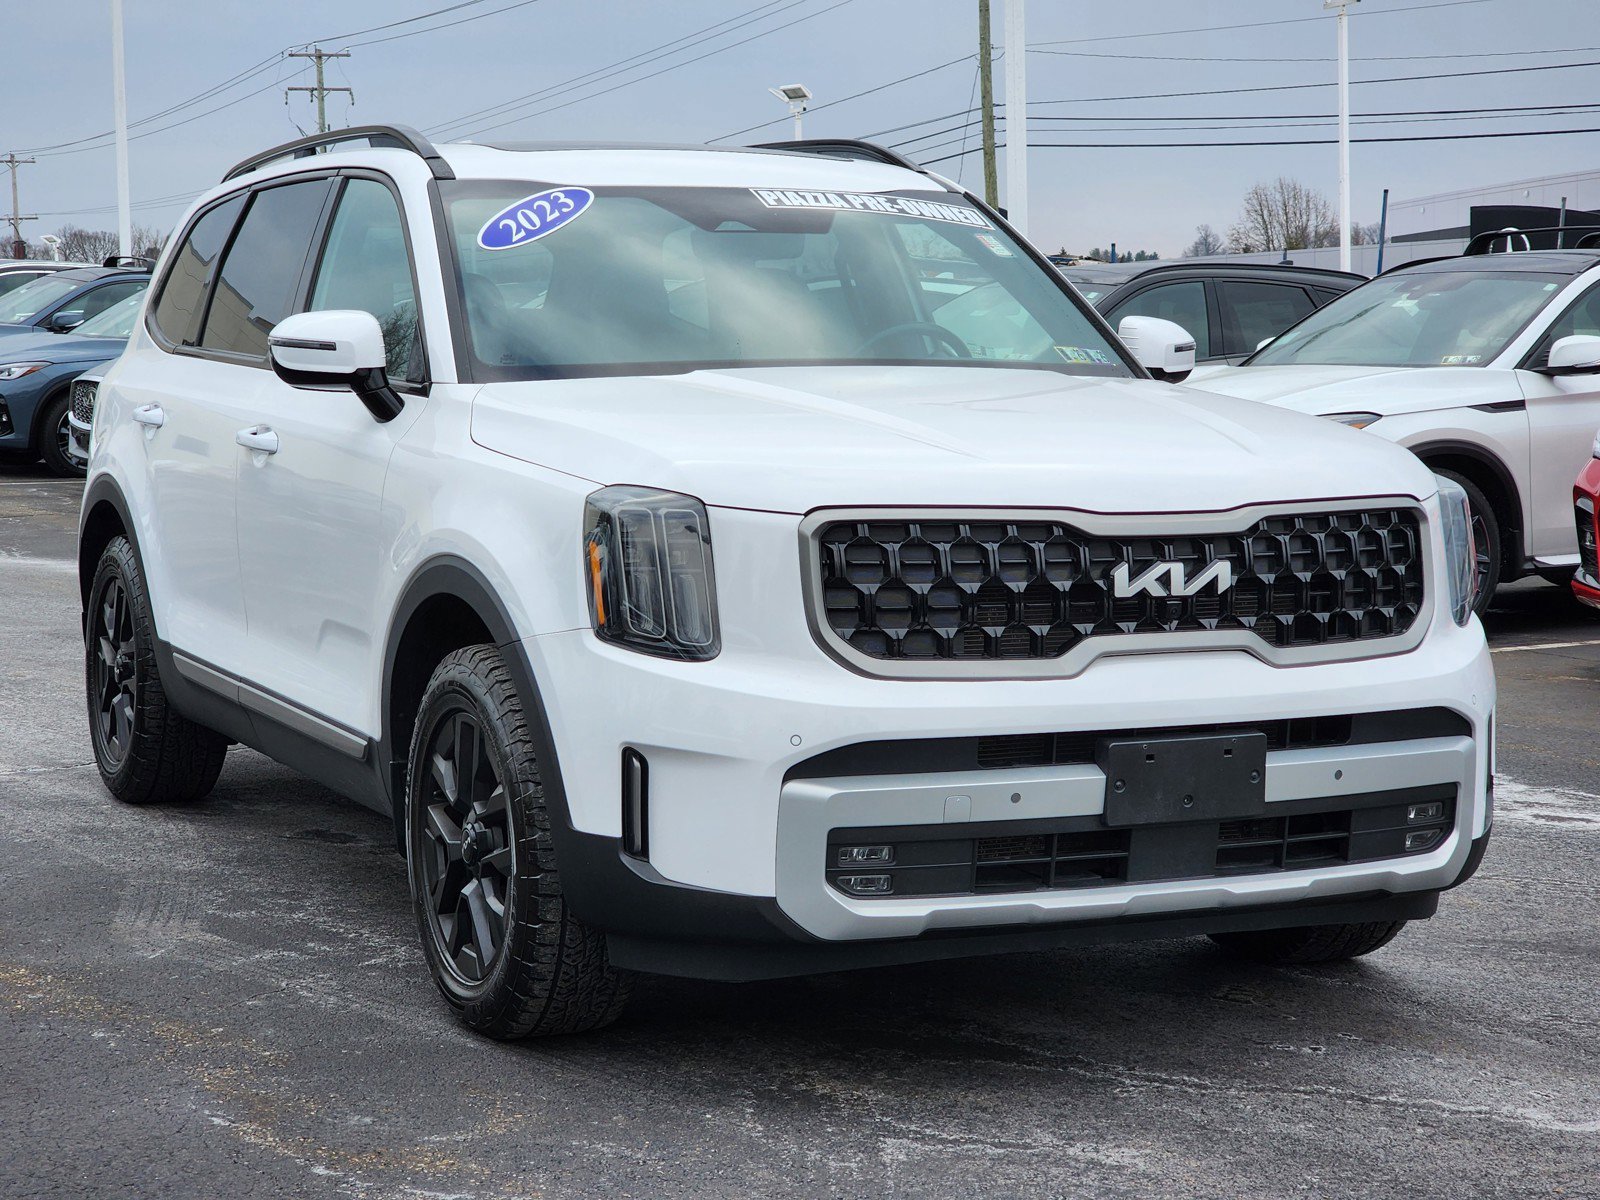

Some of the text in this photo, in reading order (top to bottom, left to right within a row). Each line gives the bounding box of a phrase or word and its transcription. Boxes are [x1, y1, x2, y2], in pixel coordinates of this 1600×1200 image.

[499, 191, 575, 243] 2023
[758, 189, 987, 226] PIAZZA PRE-OWNED
[1111, 558, 1232, 598] KIA
